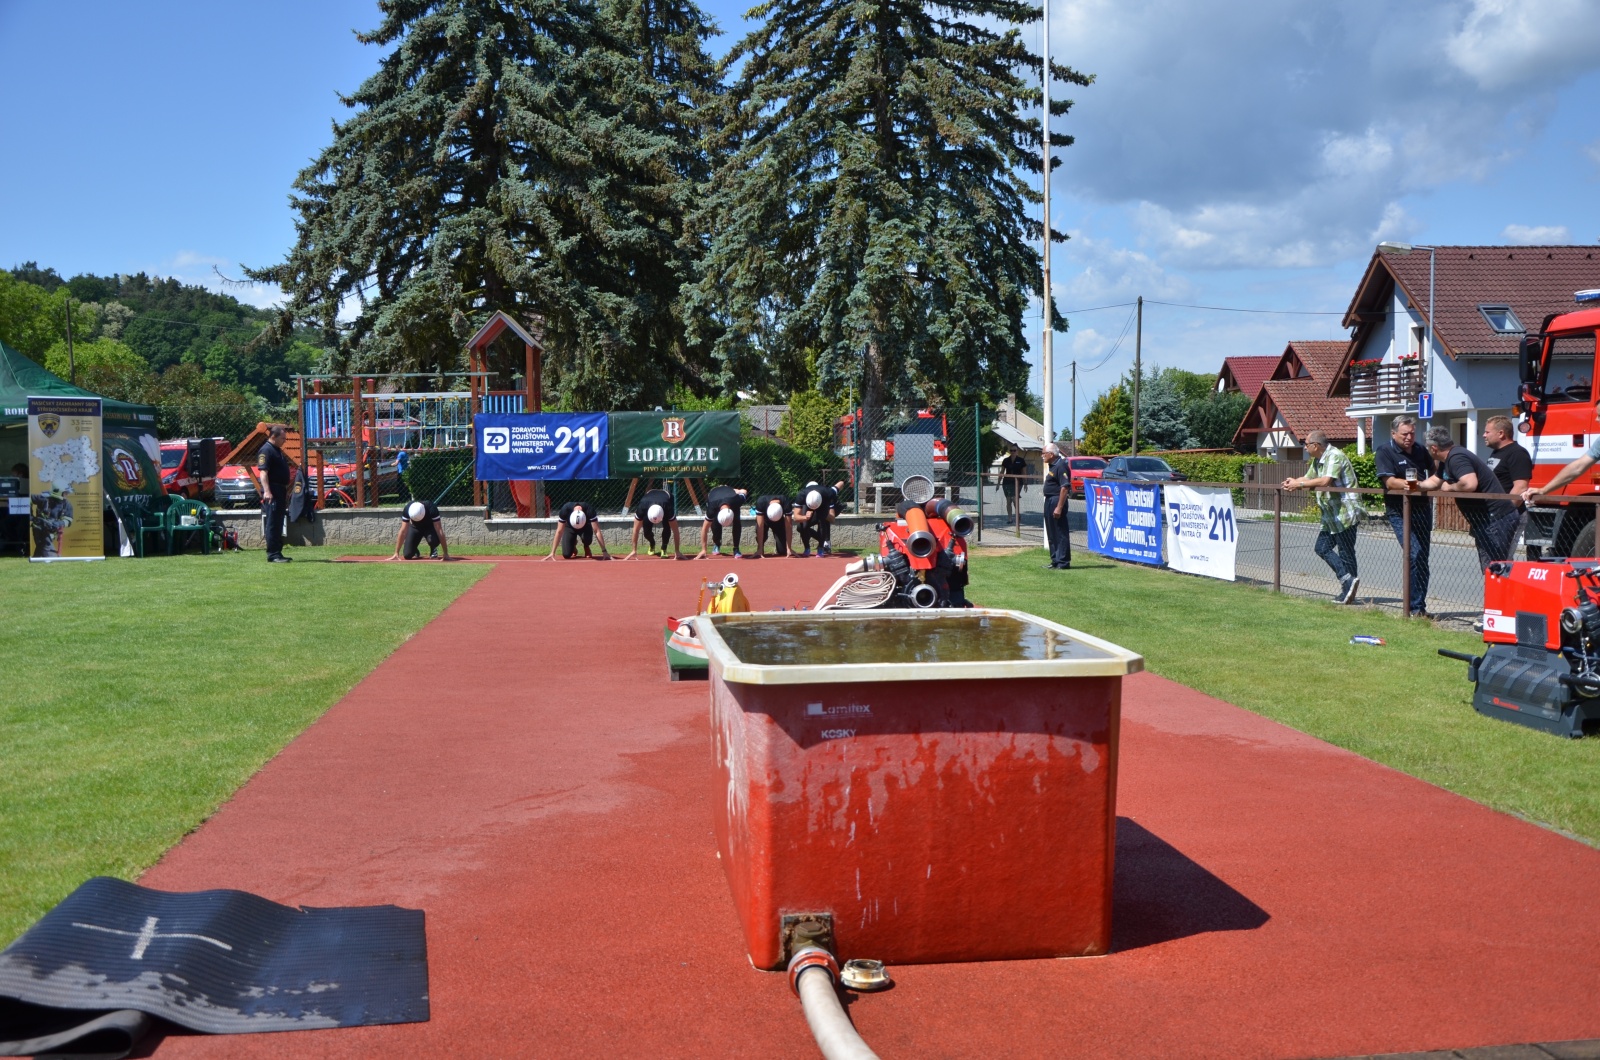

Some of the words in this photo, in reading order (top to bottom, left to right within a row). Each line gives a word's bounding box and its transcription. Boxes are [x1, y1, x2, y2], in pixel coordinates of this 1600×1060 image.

[511, 425, 547, 433] ZDRAVOTNÍ
[511, 432, 550, 440] POJIŠŤOVNA
[666, 421, 681, 438] R
[554, 426, 600, 454] 211
[534, 446, 544, 454] ČR
[627, 447, 719, 462] ROHOZEC
[660, 465, 691, 473] ČESKÉHO
[692, 465, 708, 473] RÁJE
[1208, 505, 1234, 543] 211
[1527, 567, 1549, 581] FOX
